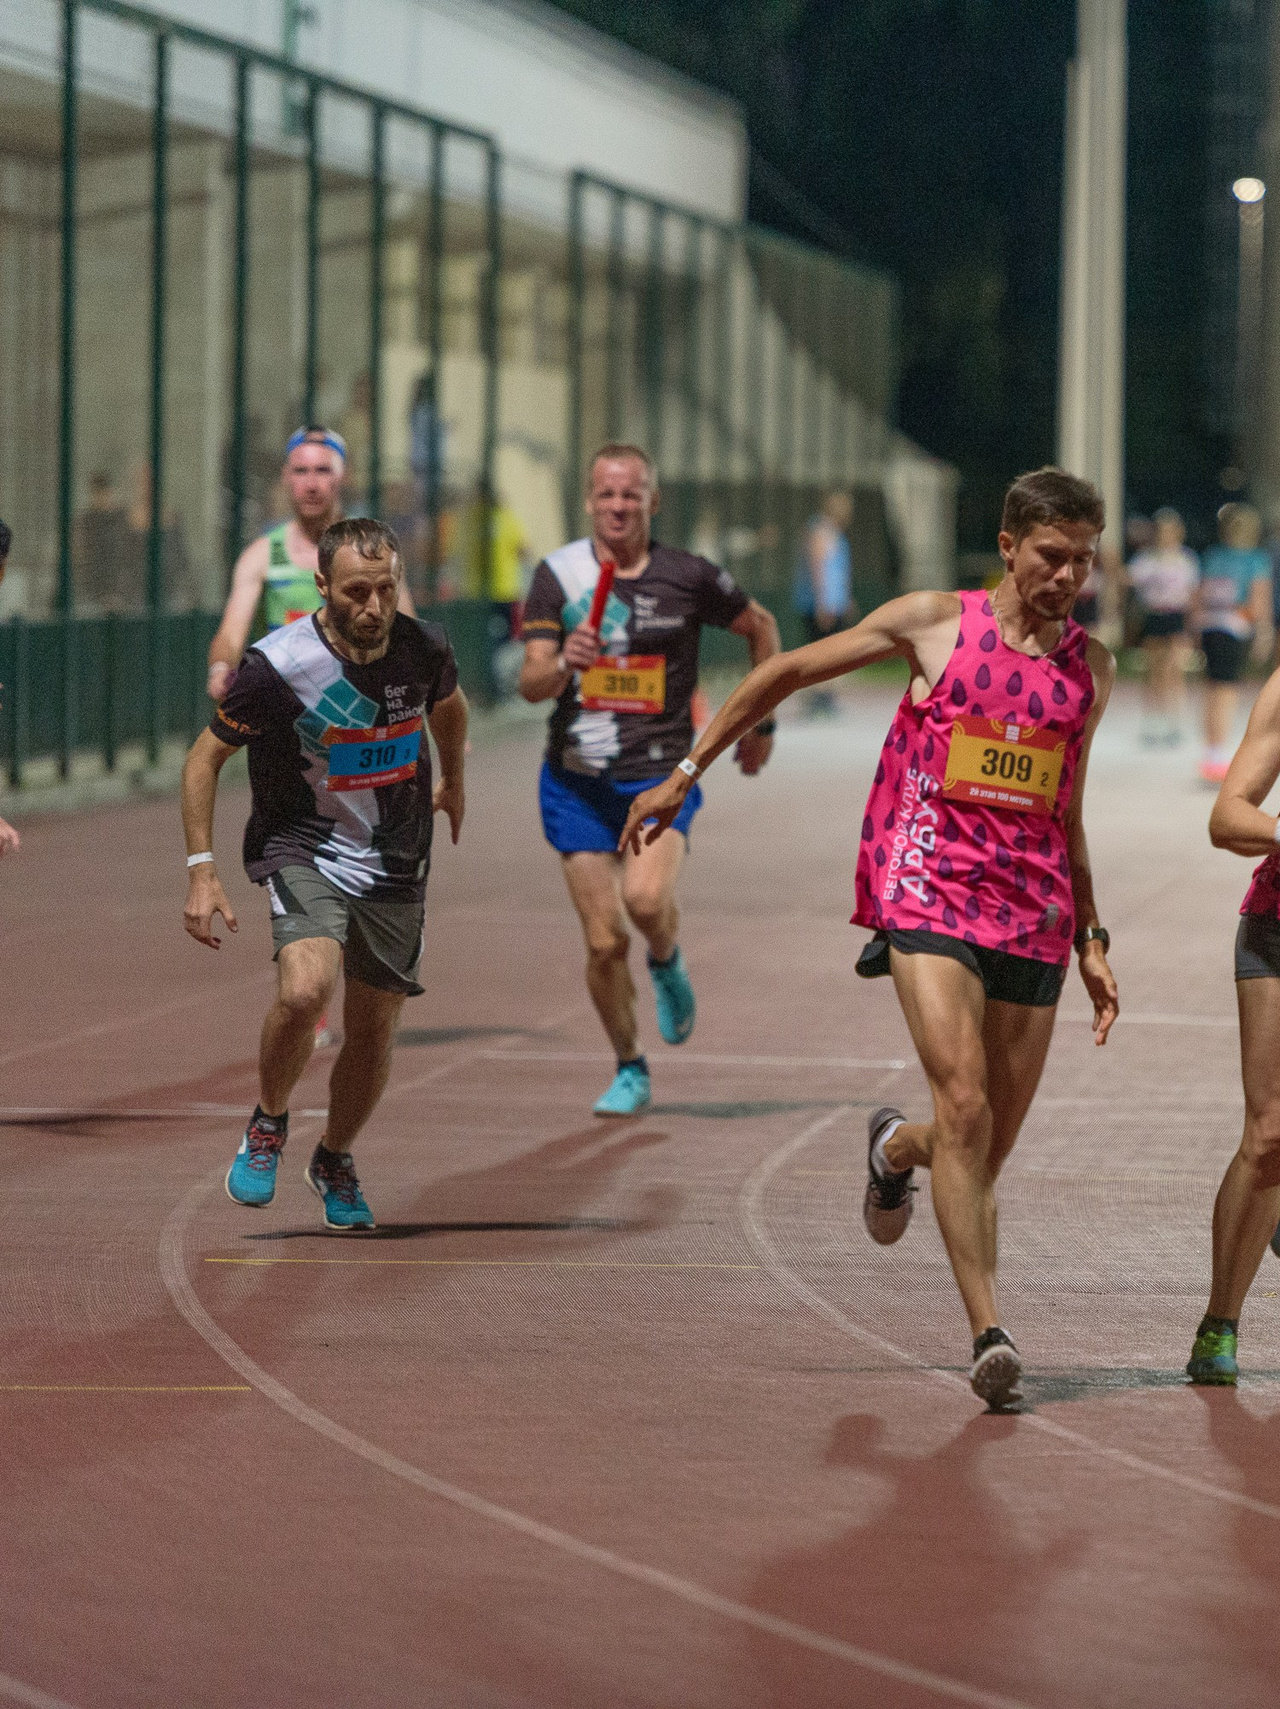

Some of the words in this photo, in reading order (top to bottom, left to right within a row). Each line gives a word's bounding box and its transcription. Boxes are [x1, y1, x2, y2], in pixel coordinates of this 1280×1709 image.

[384, 684, 408, 699] бег
[386, 698, 404, 711] на
[360, 745, 396, 768] 310
[981, 748, 1032, 782] 309
[1040, 772, 1049, 787] 2
[883, 821, 909, 900] БЕГОВОЙ
[900, 768, 917, 820] КЛУБ
